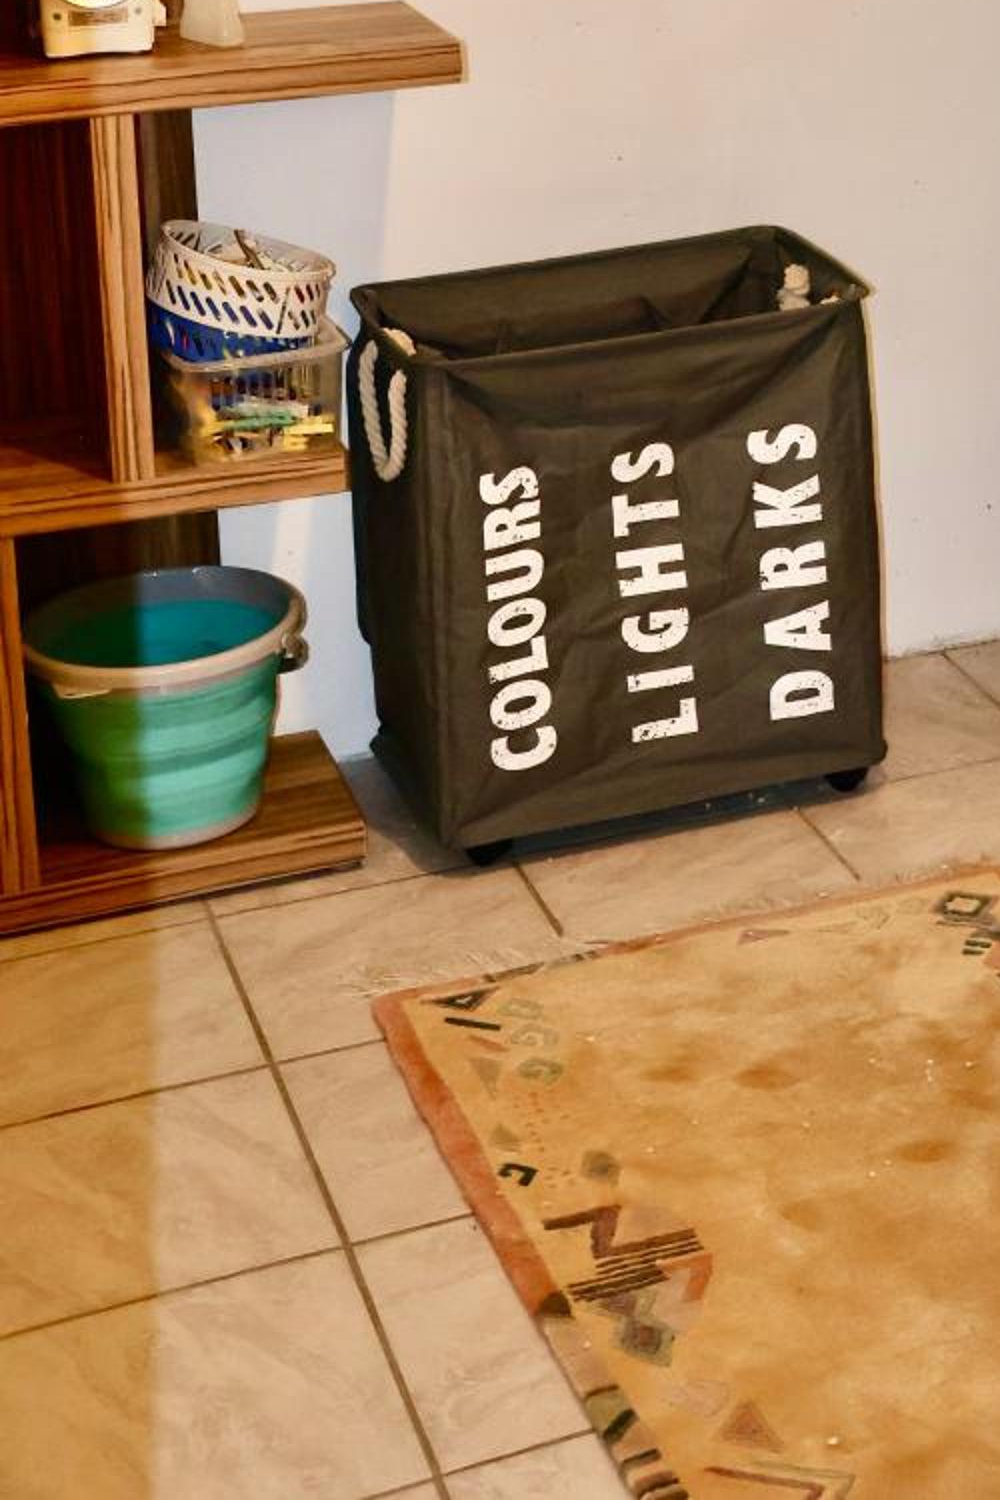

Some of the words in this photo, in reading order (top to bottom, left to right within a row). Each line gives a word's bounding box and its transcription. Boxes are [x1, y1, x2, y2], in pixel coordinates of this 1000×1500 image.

[479, 466, 557, 771] COLOURS
[610, 442, 699, 743] LIGHTS
[746, 423, 835, 721] DARKS
